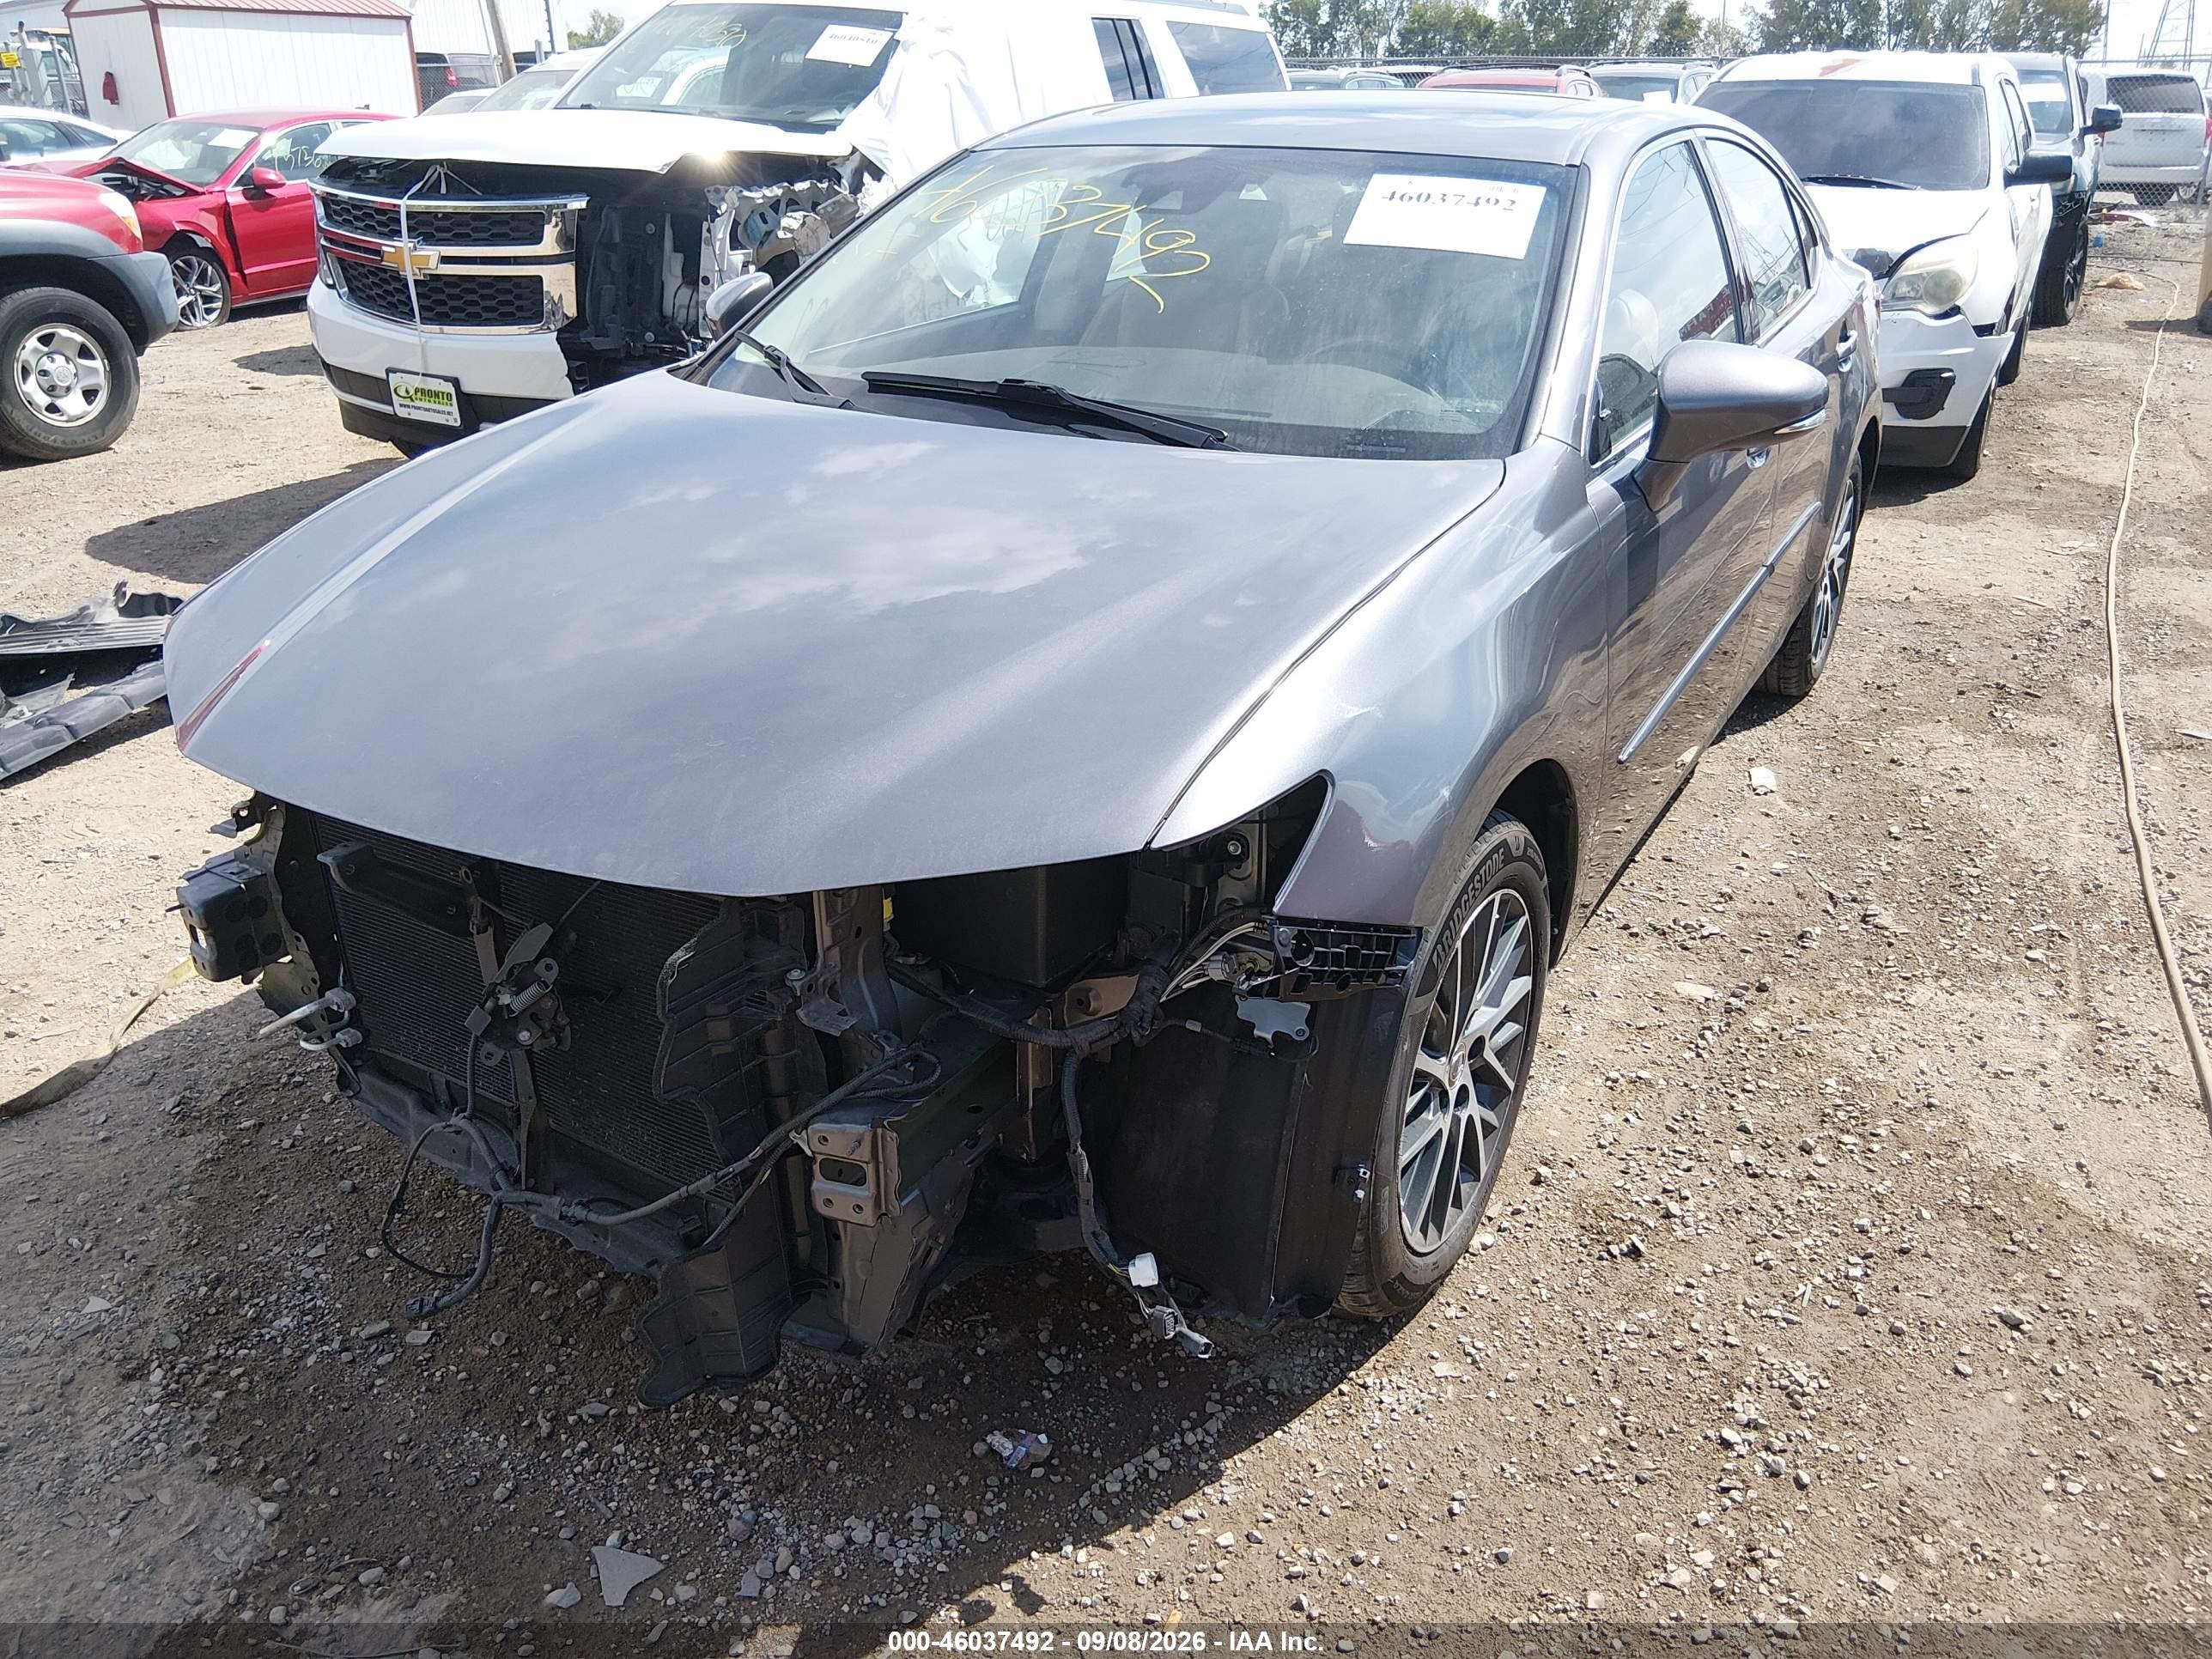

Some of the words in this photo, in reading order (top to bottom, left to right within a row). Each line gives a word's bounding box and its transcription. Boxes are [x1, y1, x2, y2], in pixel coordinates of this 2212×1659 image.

[1381, 190, 1519, 211] 46037492
[414, 386, 453, 402] PRONTO
[1431, 847, 1505, 972] BRIDGESTONE
